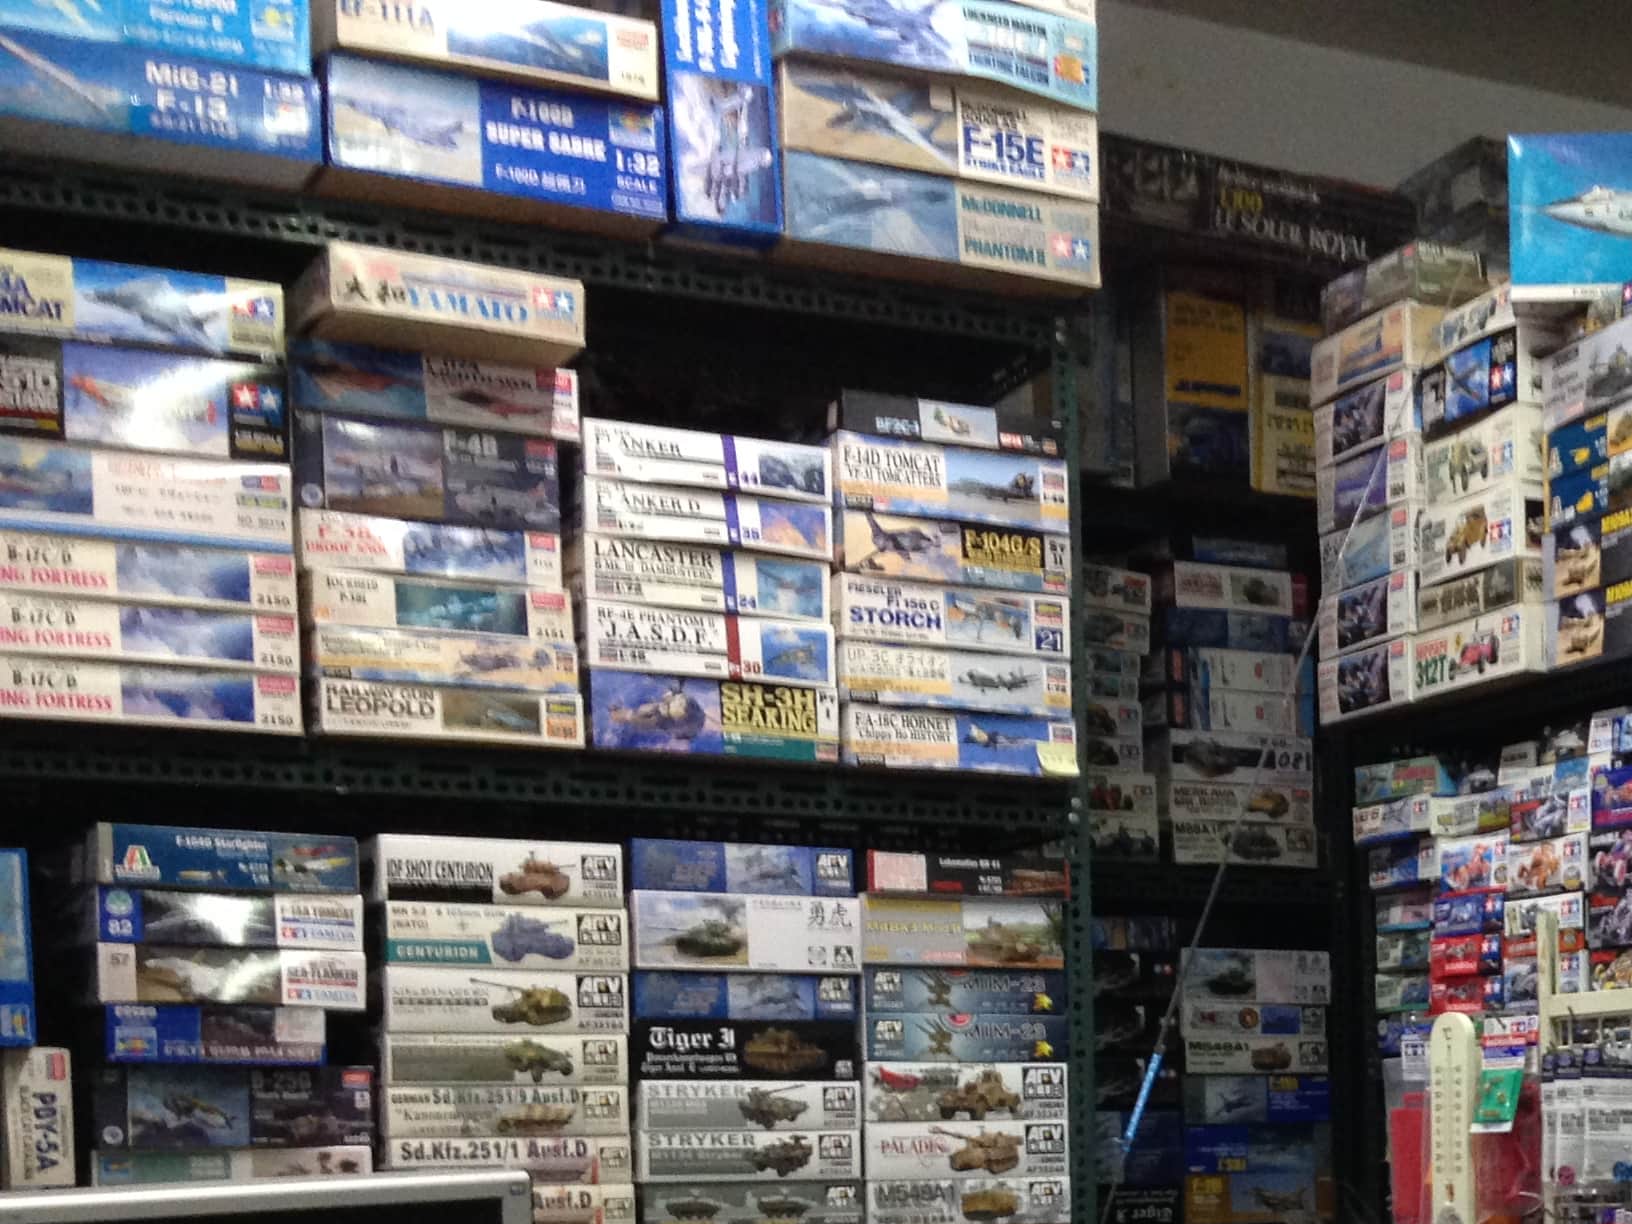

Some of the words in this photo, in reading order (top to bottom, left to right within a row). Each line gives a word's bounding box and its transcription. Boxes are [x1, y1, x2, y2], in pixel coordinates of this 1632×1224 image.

[963, 123, 1045, 168] F-15E
[885, 450, 940, 472] TOMCAT
[595, 540, 714, 568] LANCASTER
[850, 606, 942, 630] STORCH
[1039, 630, 1063, 650] 21
[326, 696, 435, 718] LEOPOLD
[723, 703, 816, 732] SEAKING
[901, 715, 950, 731] HORNET
[406, 860, 432, 879] SHOT
[435, 861, 493, 881] CENTURION
[397, 944, 479, 959] CENTURION
[649, 1026, 713, 1051] Tiger
[648, 1084, 746, 1098] STRYKER
[649, 1133, 755, 1146] STRYKER
[400, 1141, 519, 1161] Sd.Kfz.251/1
[527, 1140, 587, 1159] Ausf.D
